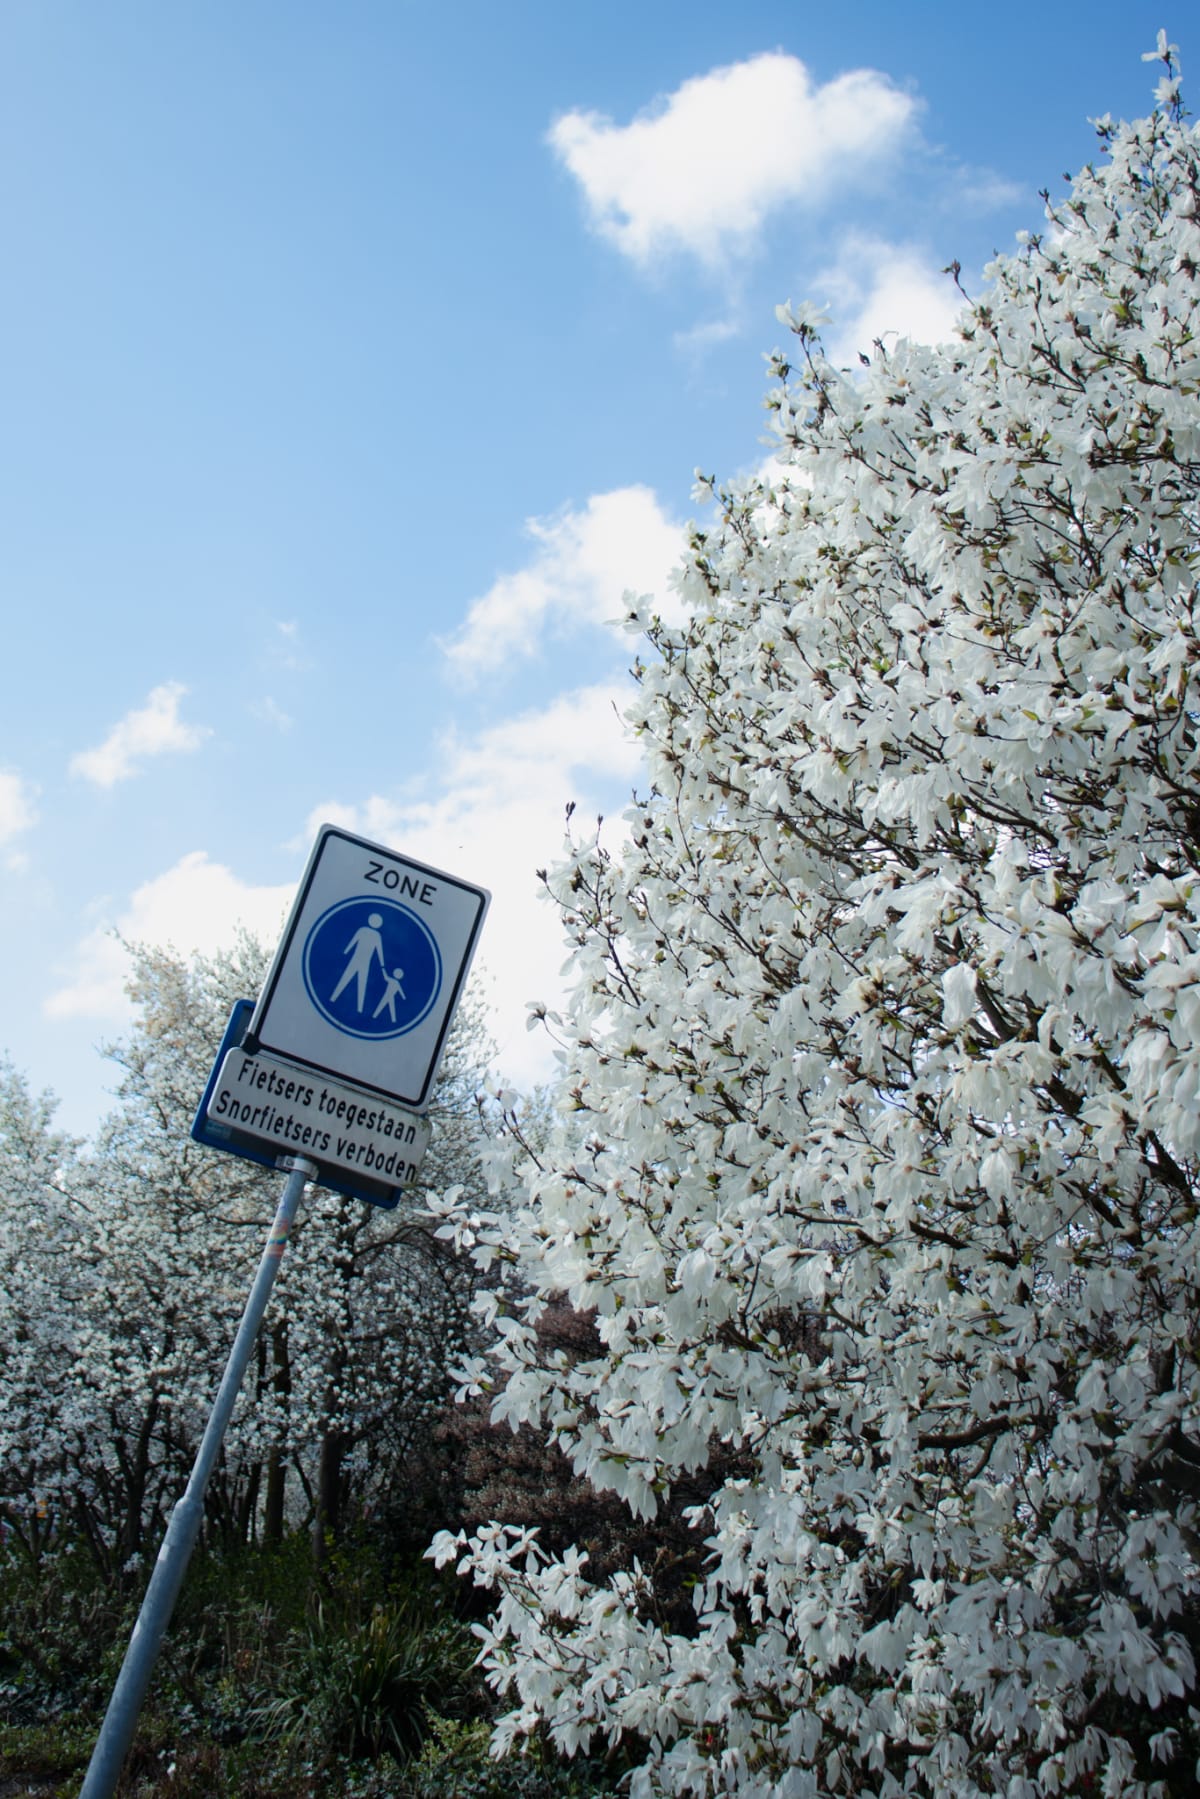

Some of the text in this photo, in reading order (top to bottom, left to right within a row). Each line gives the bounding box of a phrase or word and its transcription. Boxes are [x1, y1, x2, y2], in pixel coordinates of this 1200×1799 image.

[364, 861, 437, 906] ZONE
[216, 1090, 417, 1183] Snorfietsers verboden
[238, 1058, 417, 1145] Fietsers toegestaan
